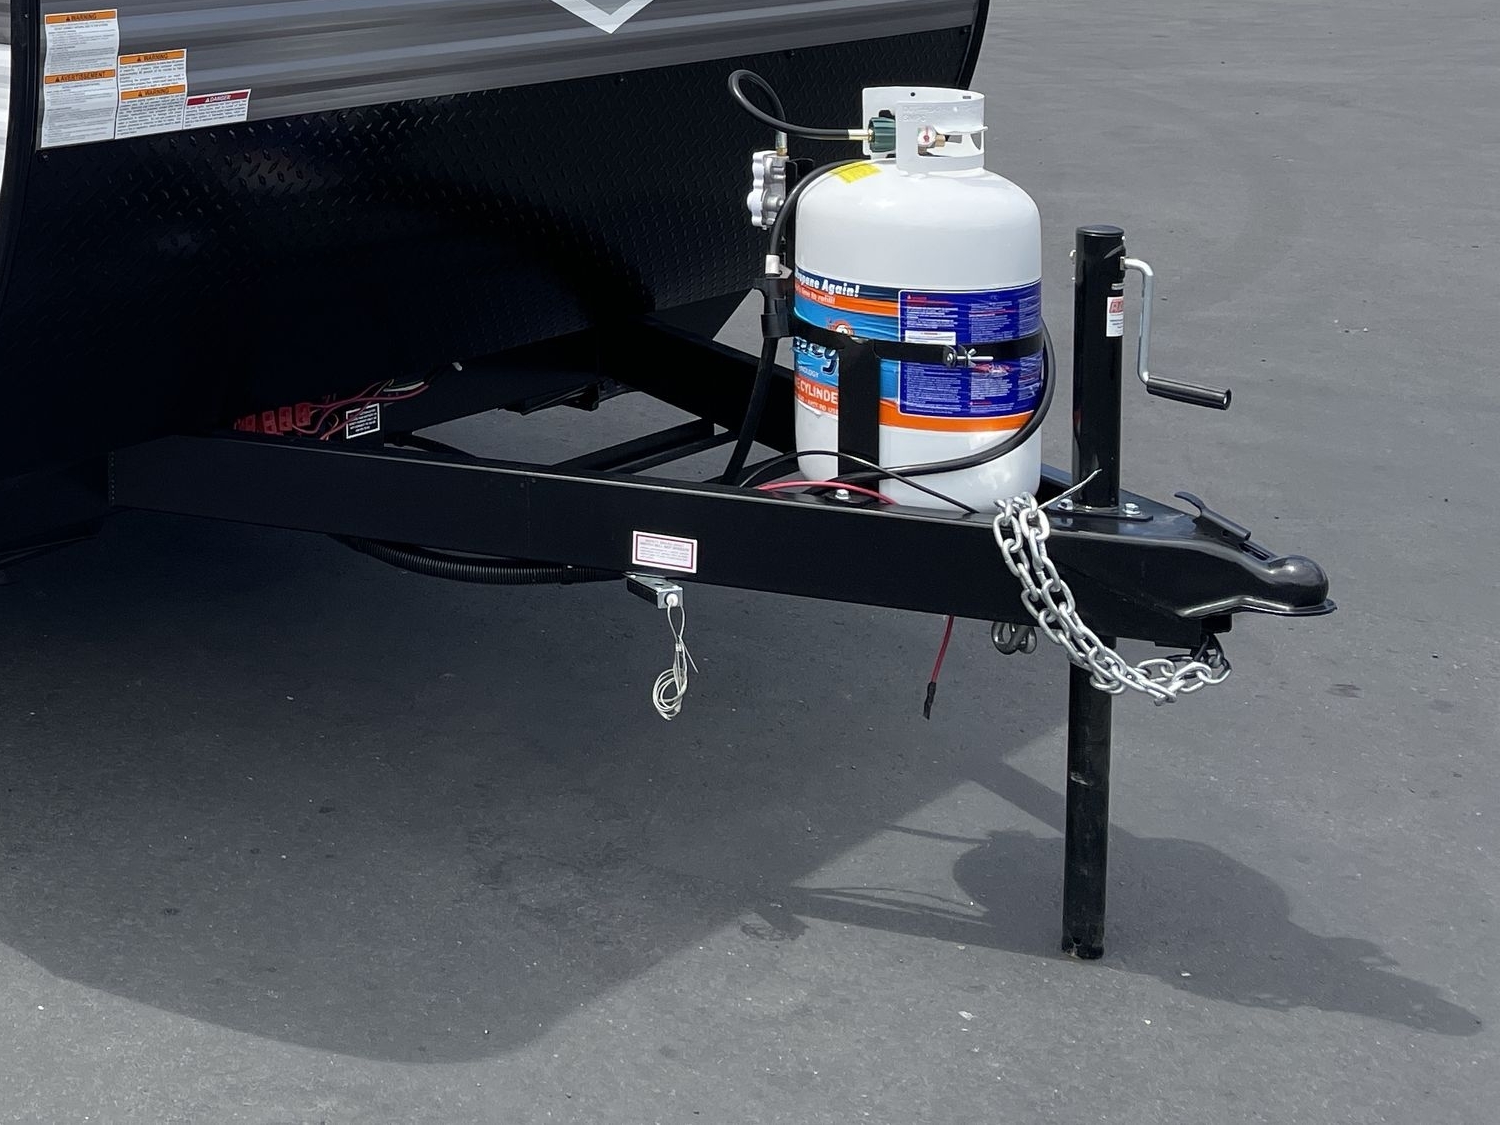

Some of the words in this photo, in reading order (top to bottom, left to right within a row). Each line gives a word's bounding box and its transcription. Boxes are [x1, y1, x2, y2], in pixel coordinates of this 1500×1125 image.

[71, 13, 97, 22] WARNING
[143, 53, 169, 62] WARNING
[60, 71, 105, 83] AVERTISSEMENT
[144, 87, 170, 96] WARNING
[209, 94, 232, 103] DANGER
[822, 278, 860, 298] Again!
